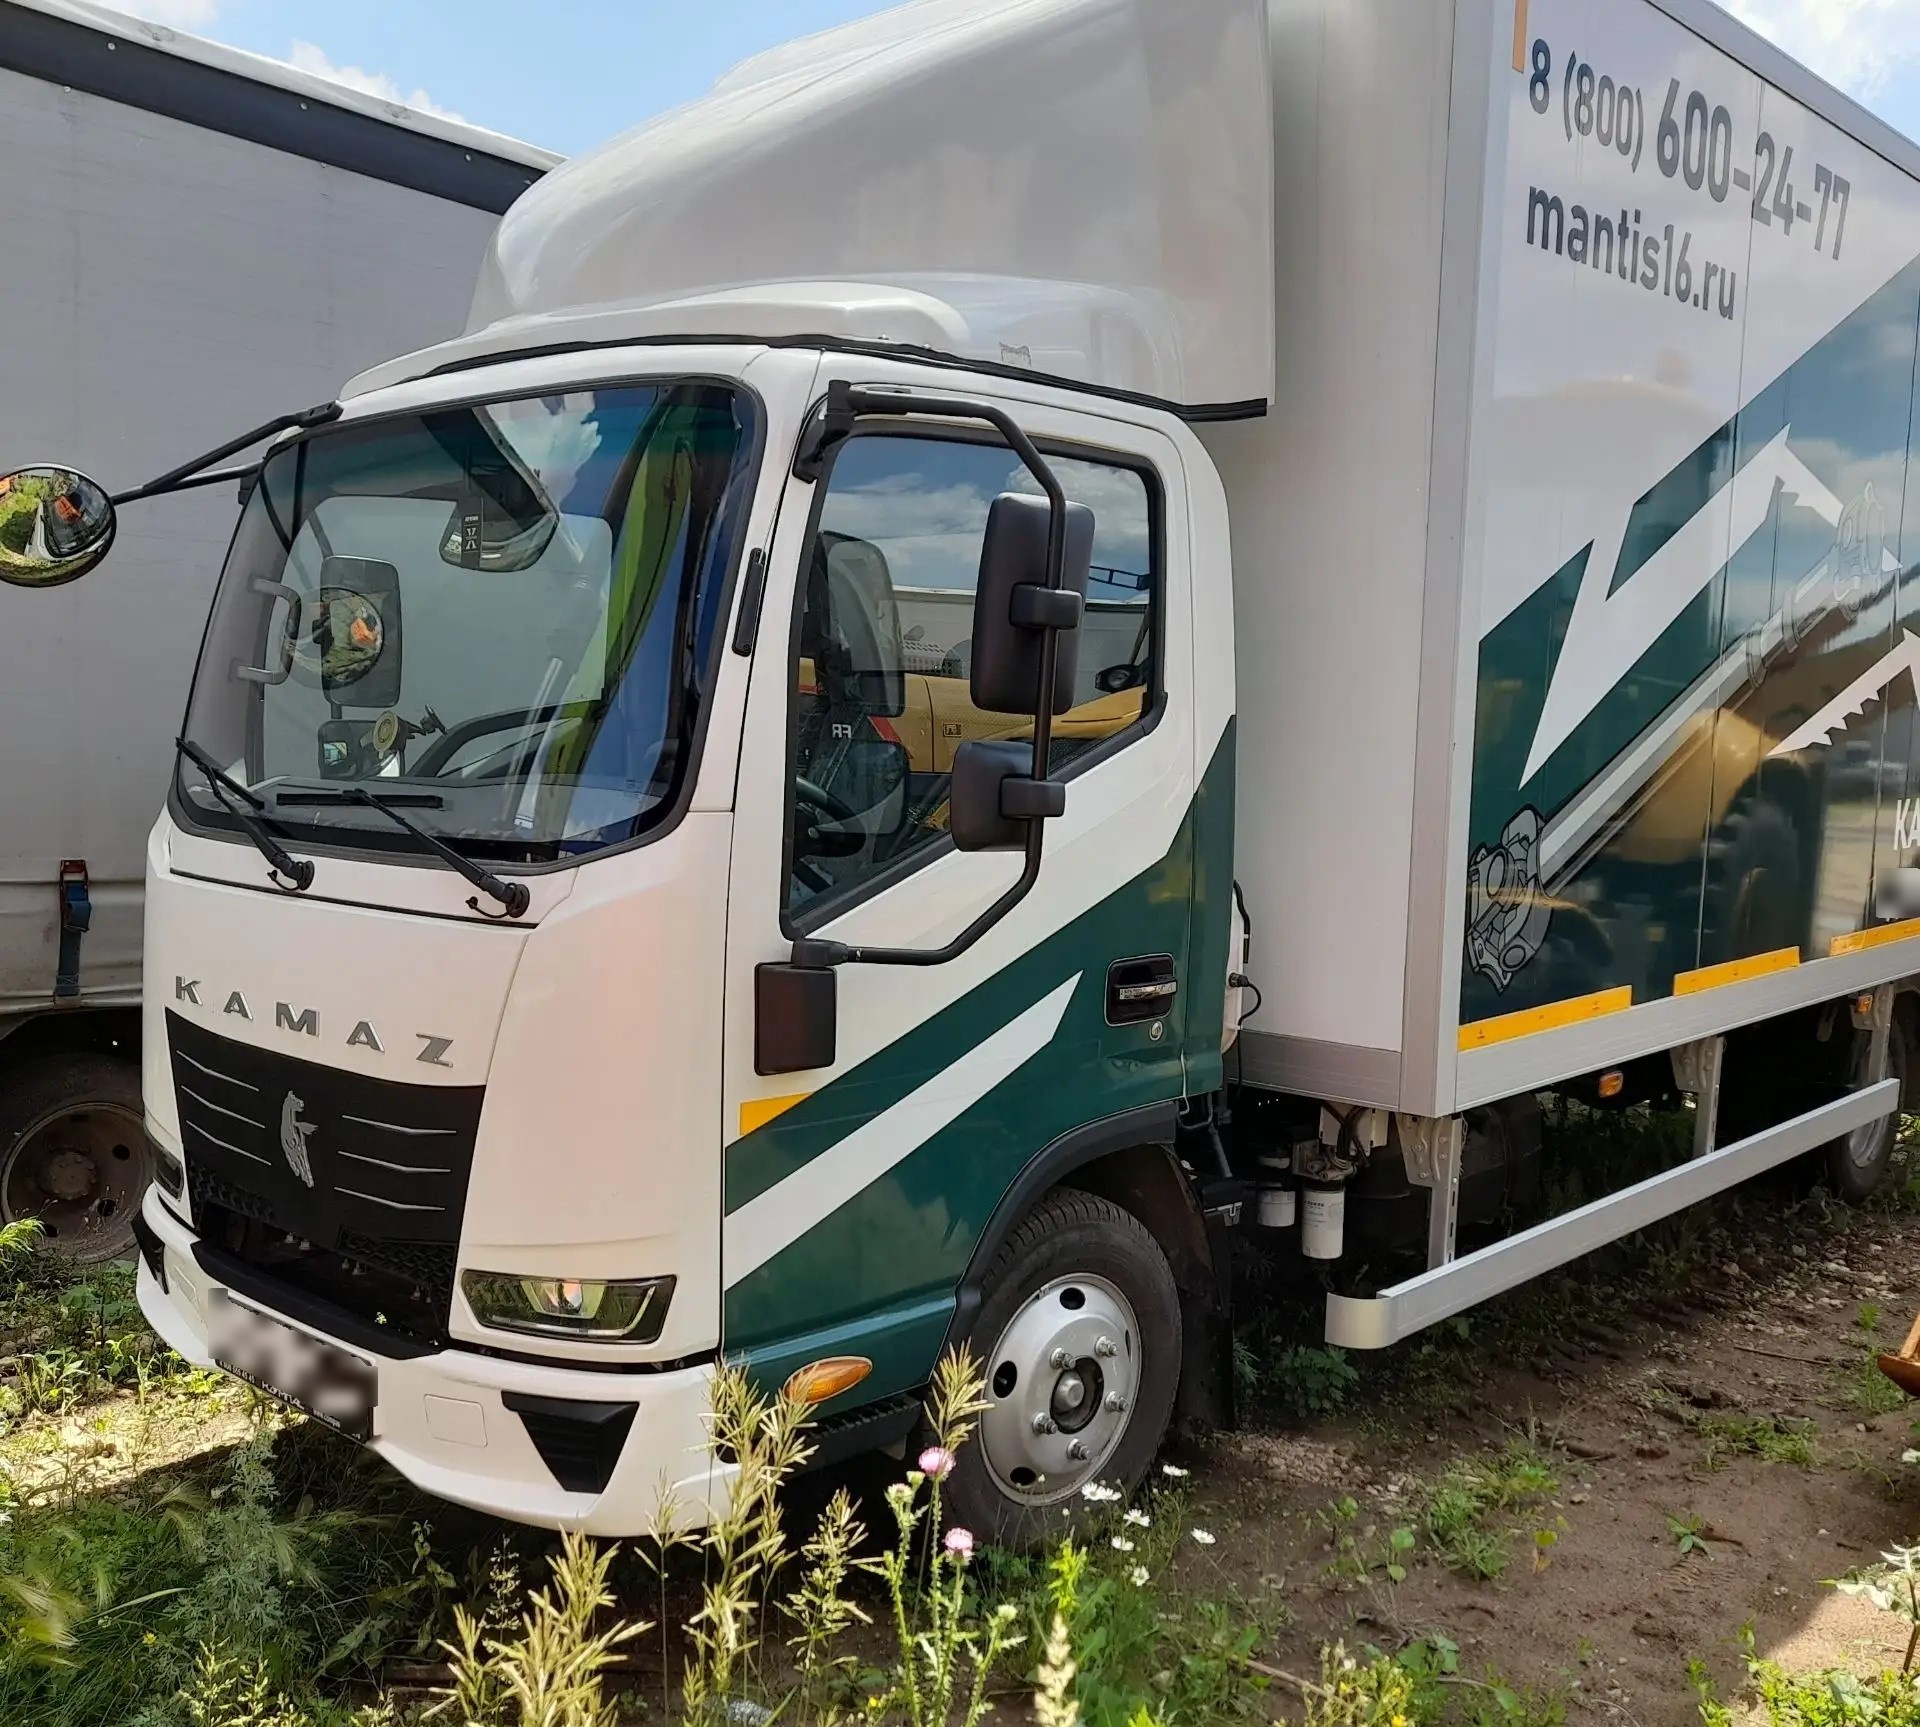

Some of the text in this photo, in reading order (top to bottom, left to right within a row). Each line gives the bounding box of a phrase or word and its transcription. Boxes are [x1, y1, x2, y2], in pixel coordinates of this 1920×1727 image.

[1529, 38, 1851, 261] 8 (800) 600-24-77
[1526, 184, 1737, 321] mantis16.ru
[175, 975, 455, 1068] KAMAZ
